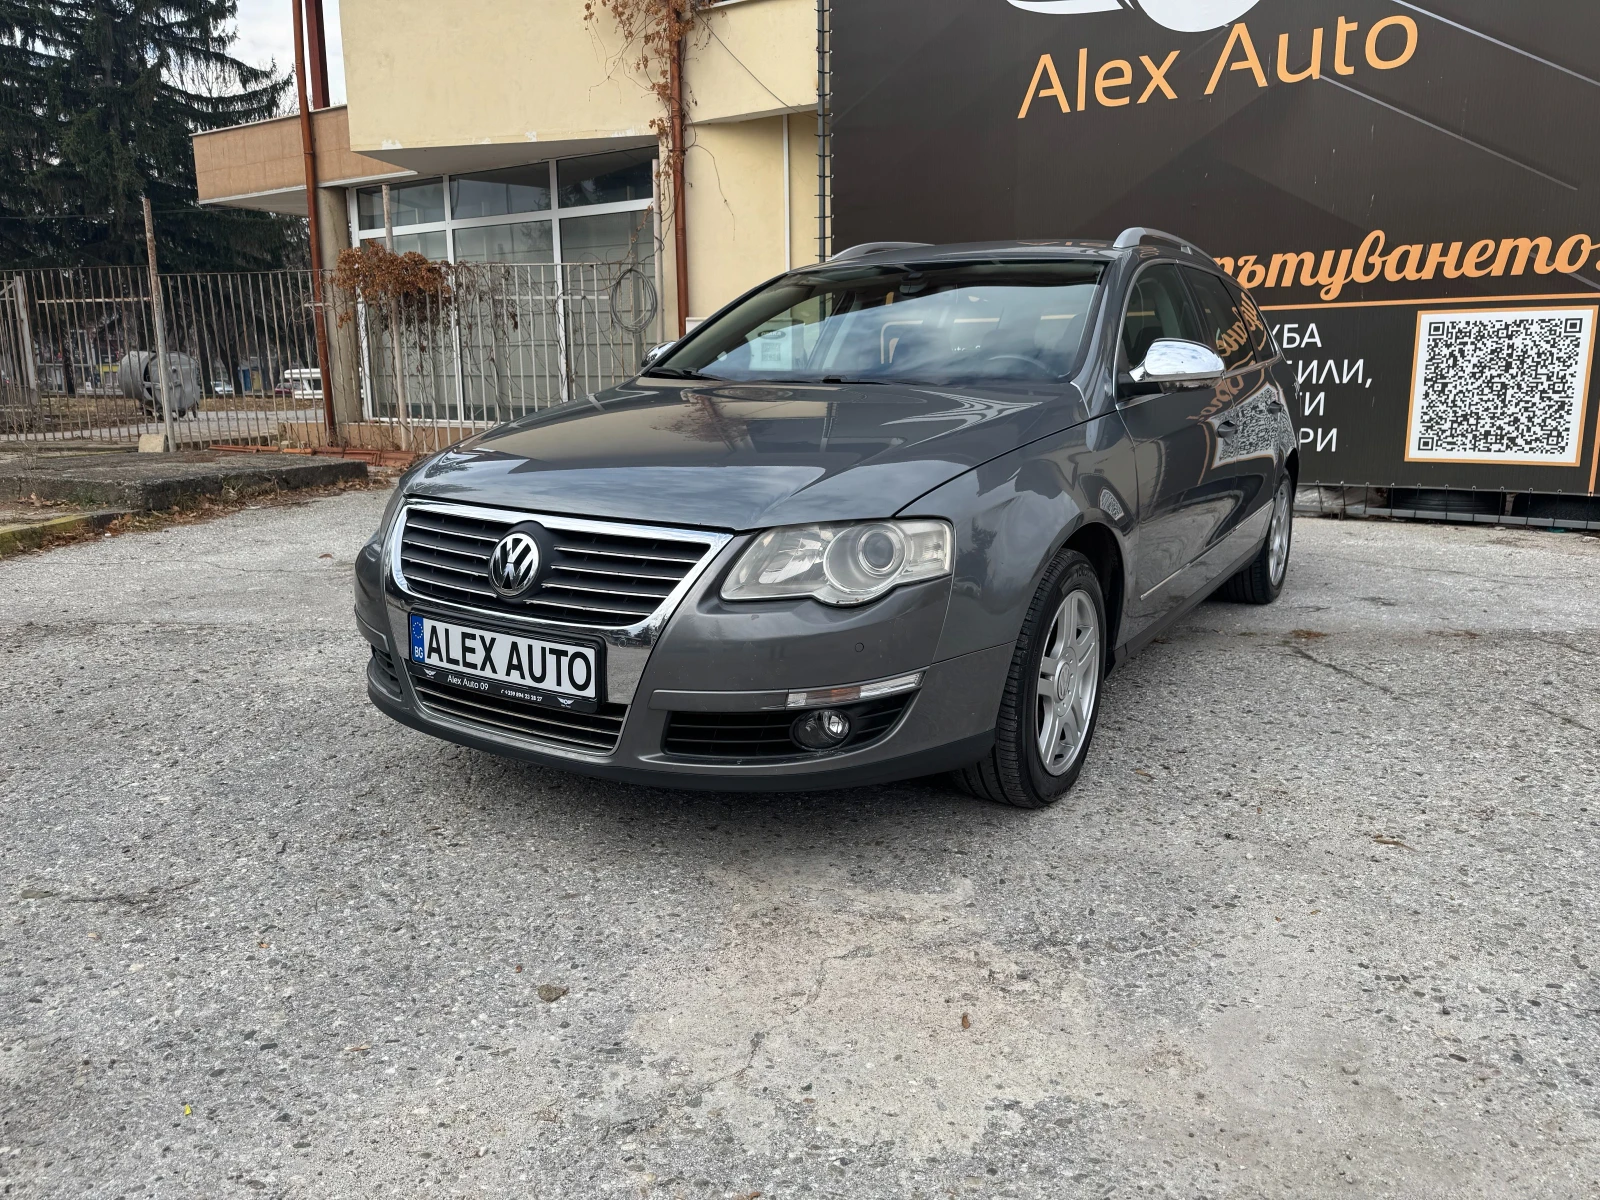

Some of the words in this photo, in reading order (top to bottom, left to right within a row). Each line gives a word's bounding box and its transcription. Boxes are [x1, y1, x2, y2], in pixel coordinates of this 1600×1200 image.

[1017, 47, 1181, 119] Alex
[1203, 15, 1418, 95] Auto
[1287, 358, 1373, 389] ИЛИ,
[414, 646, 424, 659] BG
[427, 625, 498, 675] ALEX
[505, 641, 592, 692] AUTO
[447, 674, 462, 685] Alex
[463, 678, 479, 689] Auto
[480, 682, 489, 691] 09
